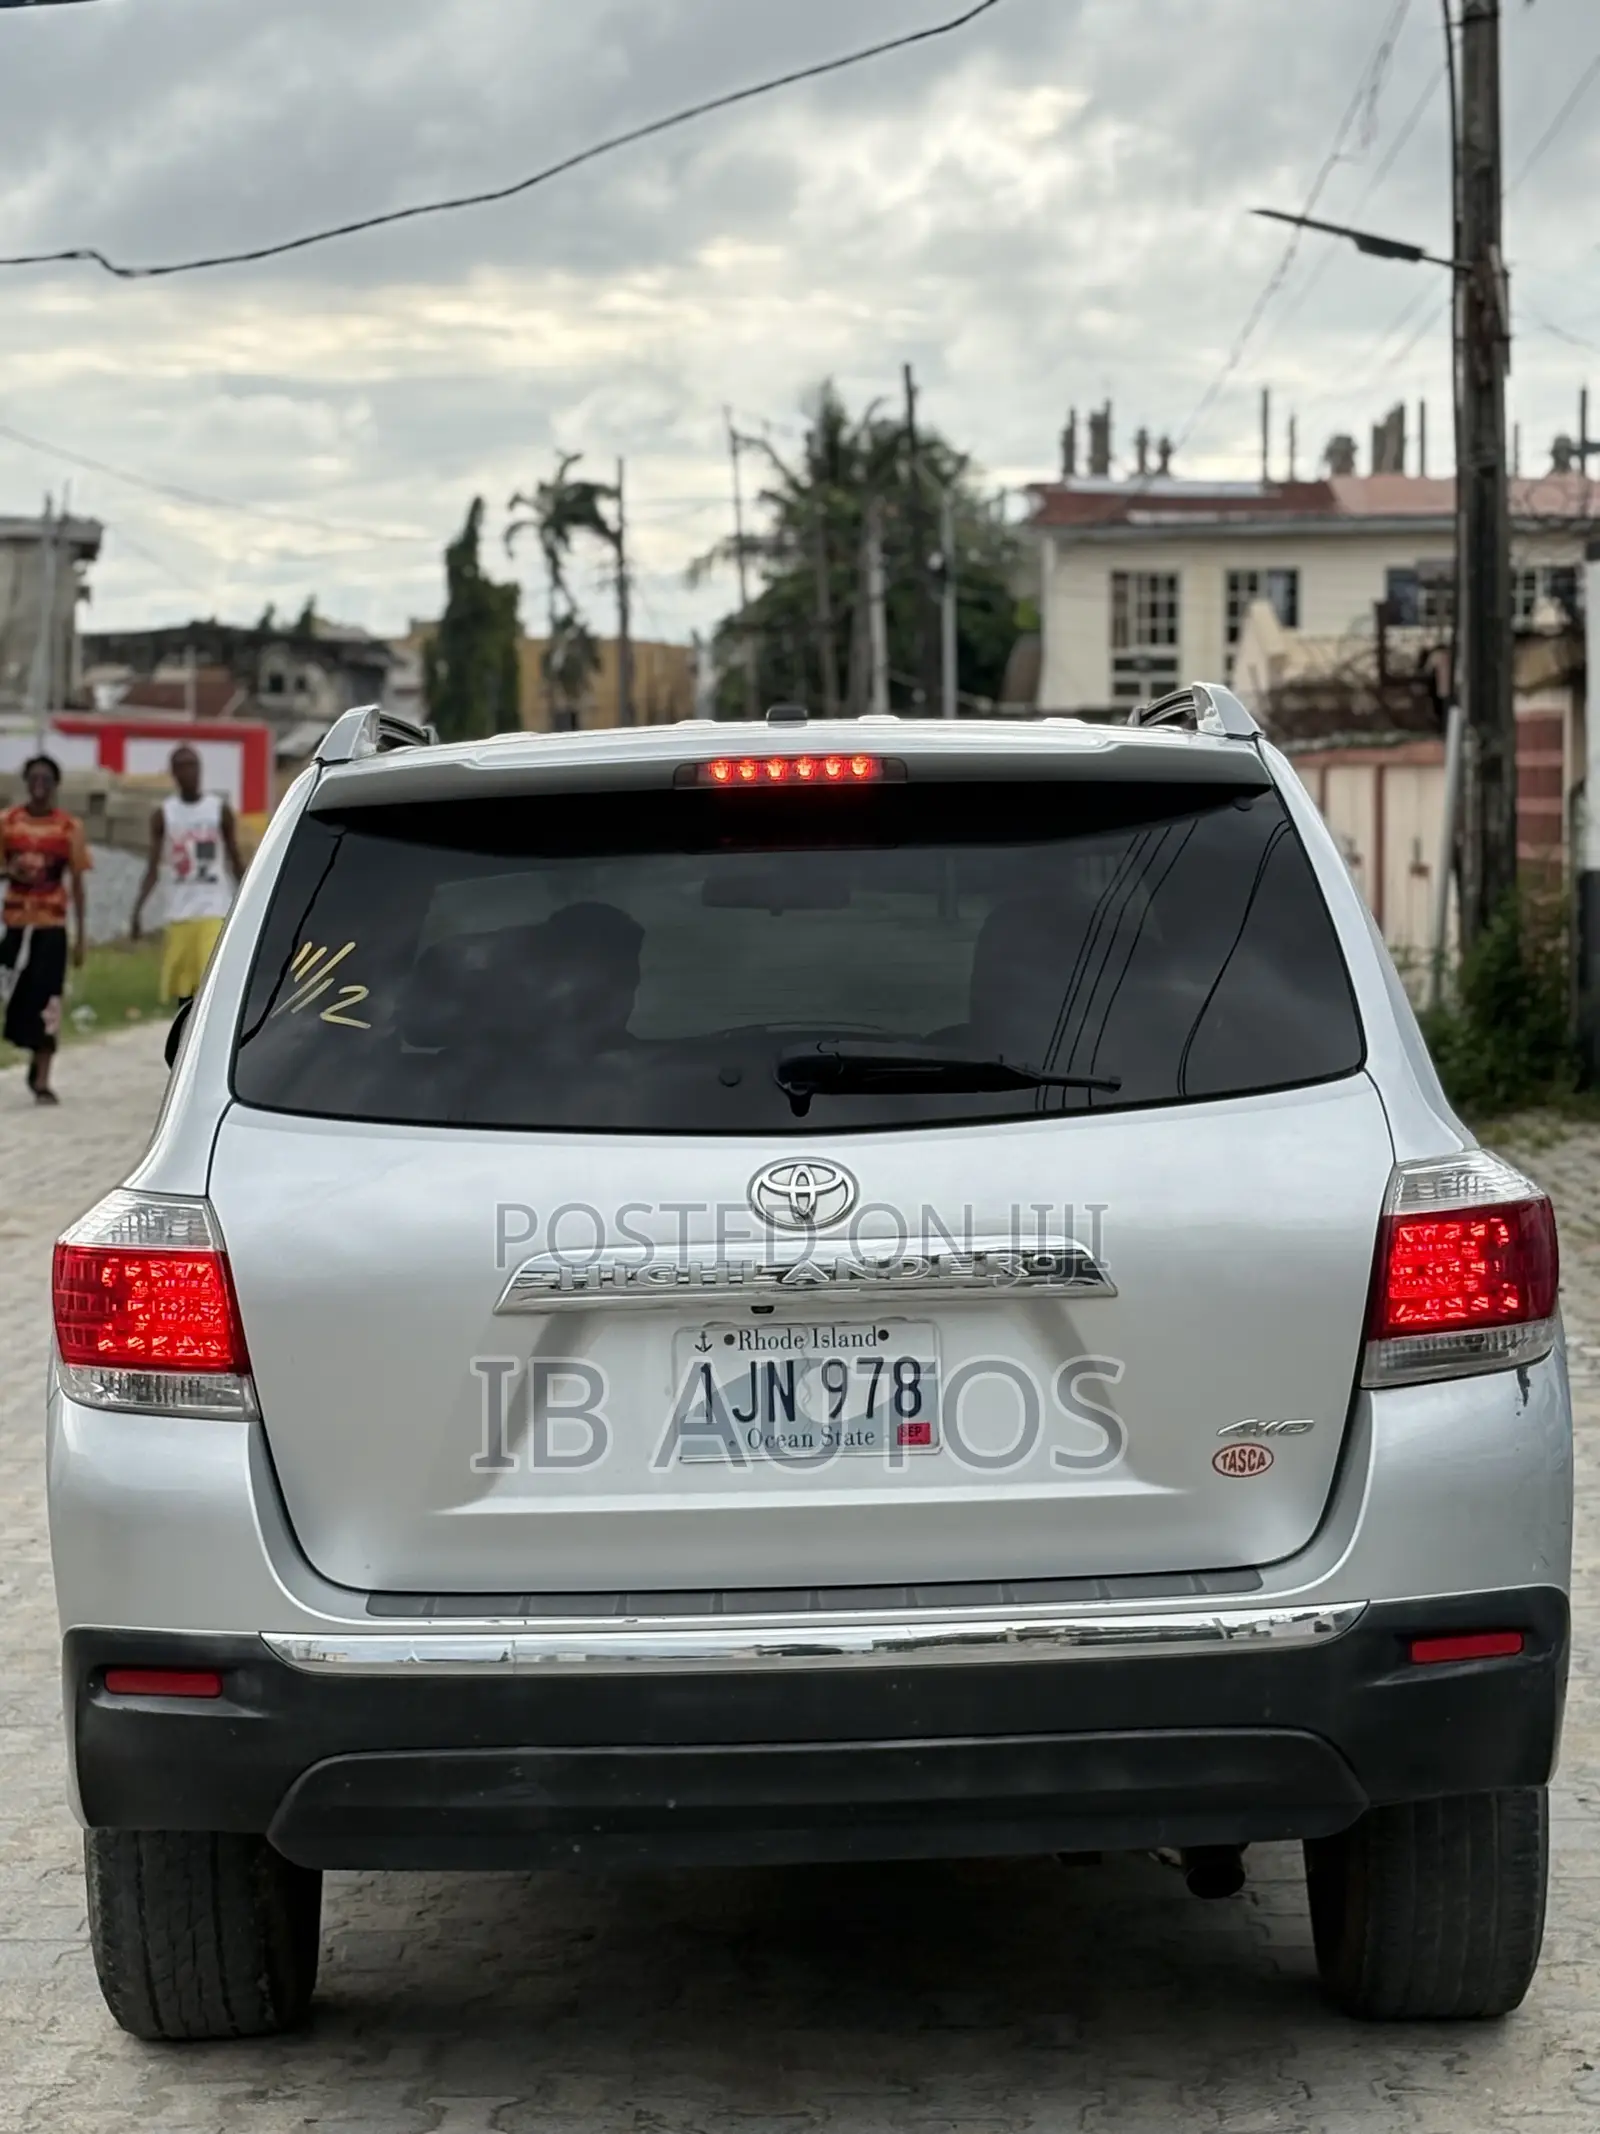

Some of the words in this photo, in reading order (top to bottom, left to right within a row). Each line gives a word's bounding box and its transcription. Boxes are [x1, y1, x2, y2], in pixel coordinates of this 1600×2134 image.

[738, 1328, 805, 1351] Rhode
[811, 1326, 877, 1349] Island
[821, 1356, 922, 1420] 978
[747, 1430, 814, 1449] Ocean
[821, 1426, 875, 1447] State
[1221, 1448, 1267, 1473] TASCA
